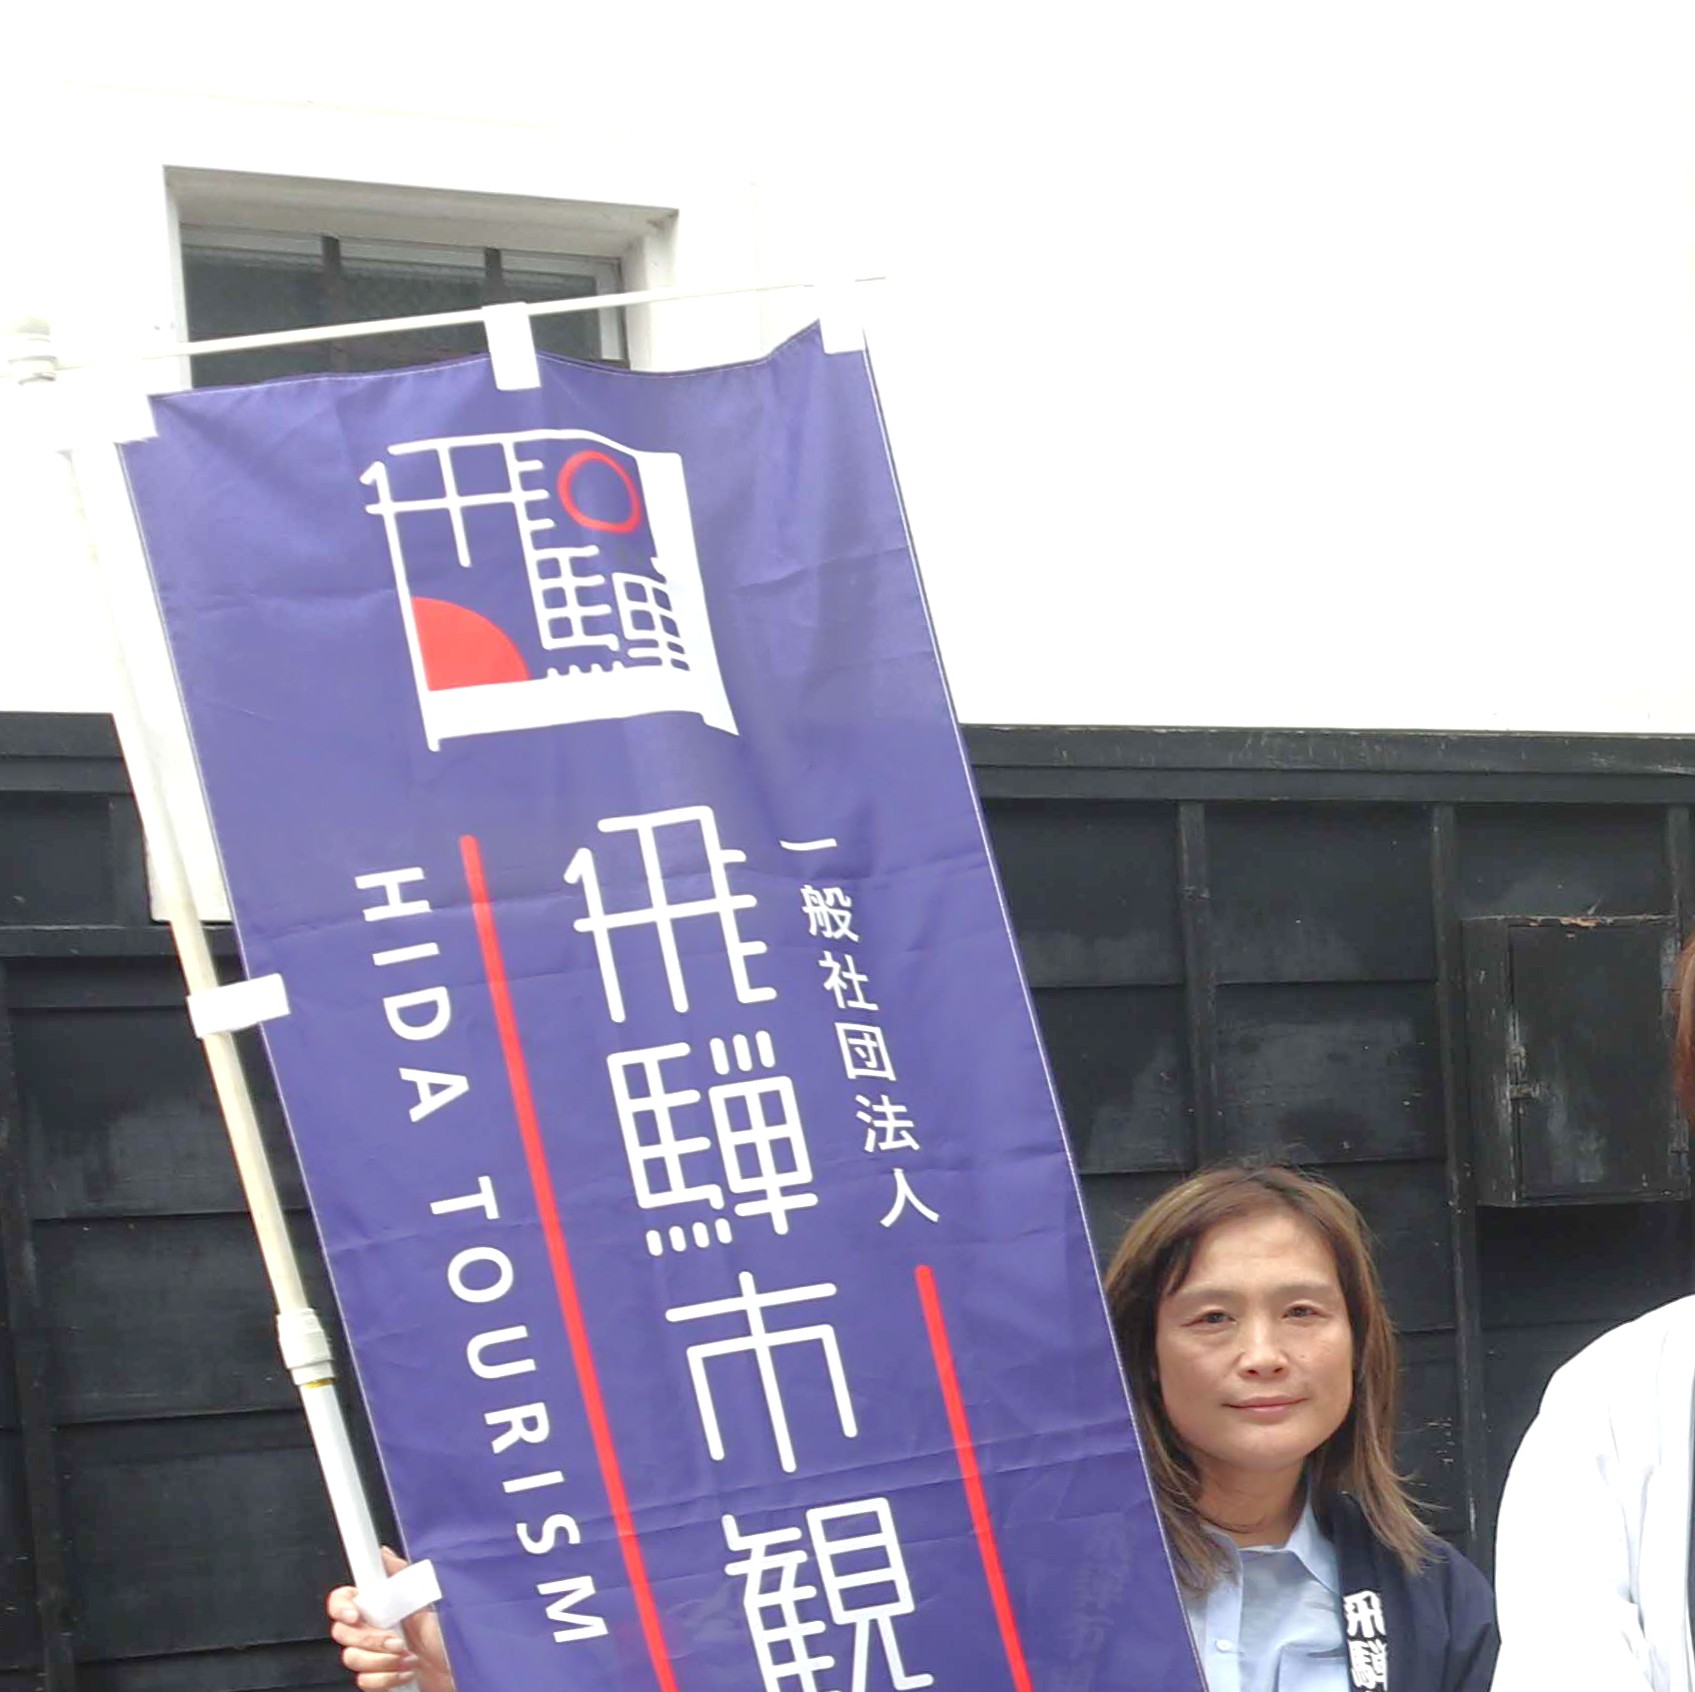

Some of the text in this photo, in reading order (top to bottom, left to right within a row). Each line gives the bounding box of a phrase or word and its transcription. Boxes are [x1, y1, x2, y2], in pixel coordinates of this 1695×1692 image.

[354, 866, 471, 1124] HIDA
[429, 1175, 610, 1645] TOURISM
[779, 836, 941, 1230] 一般社団法人
